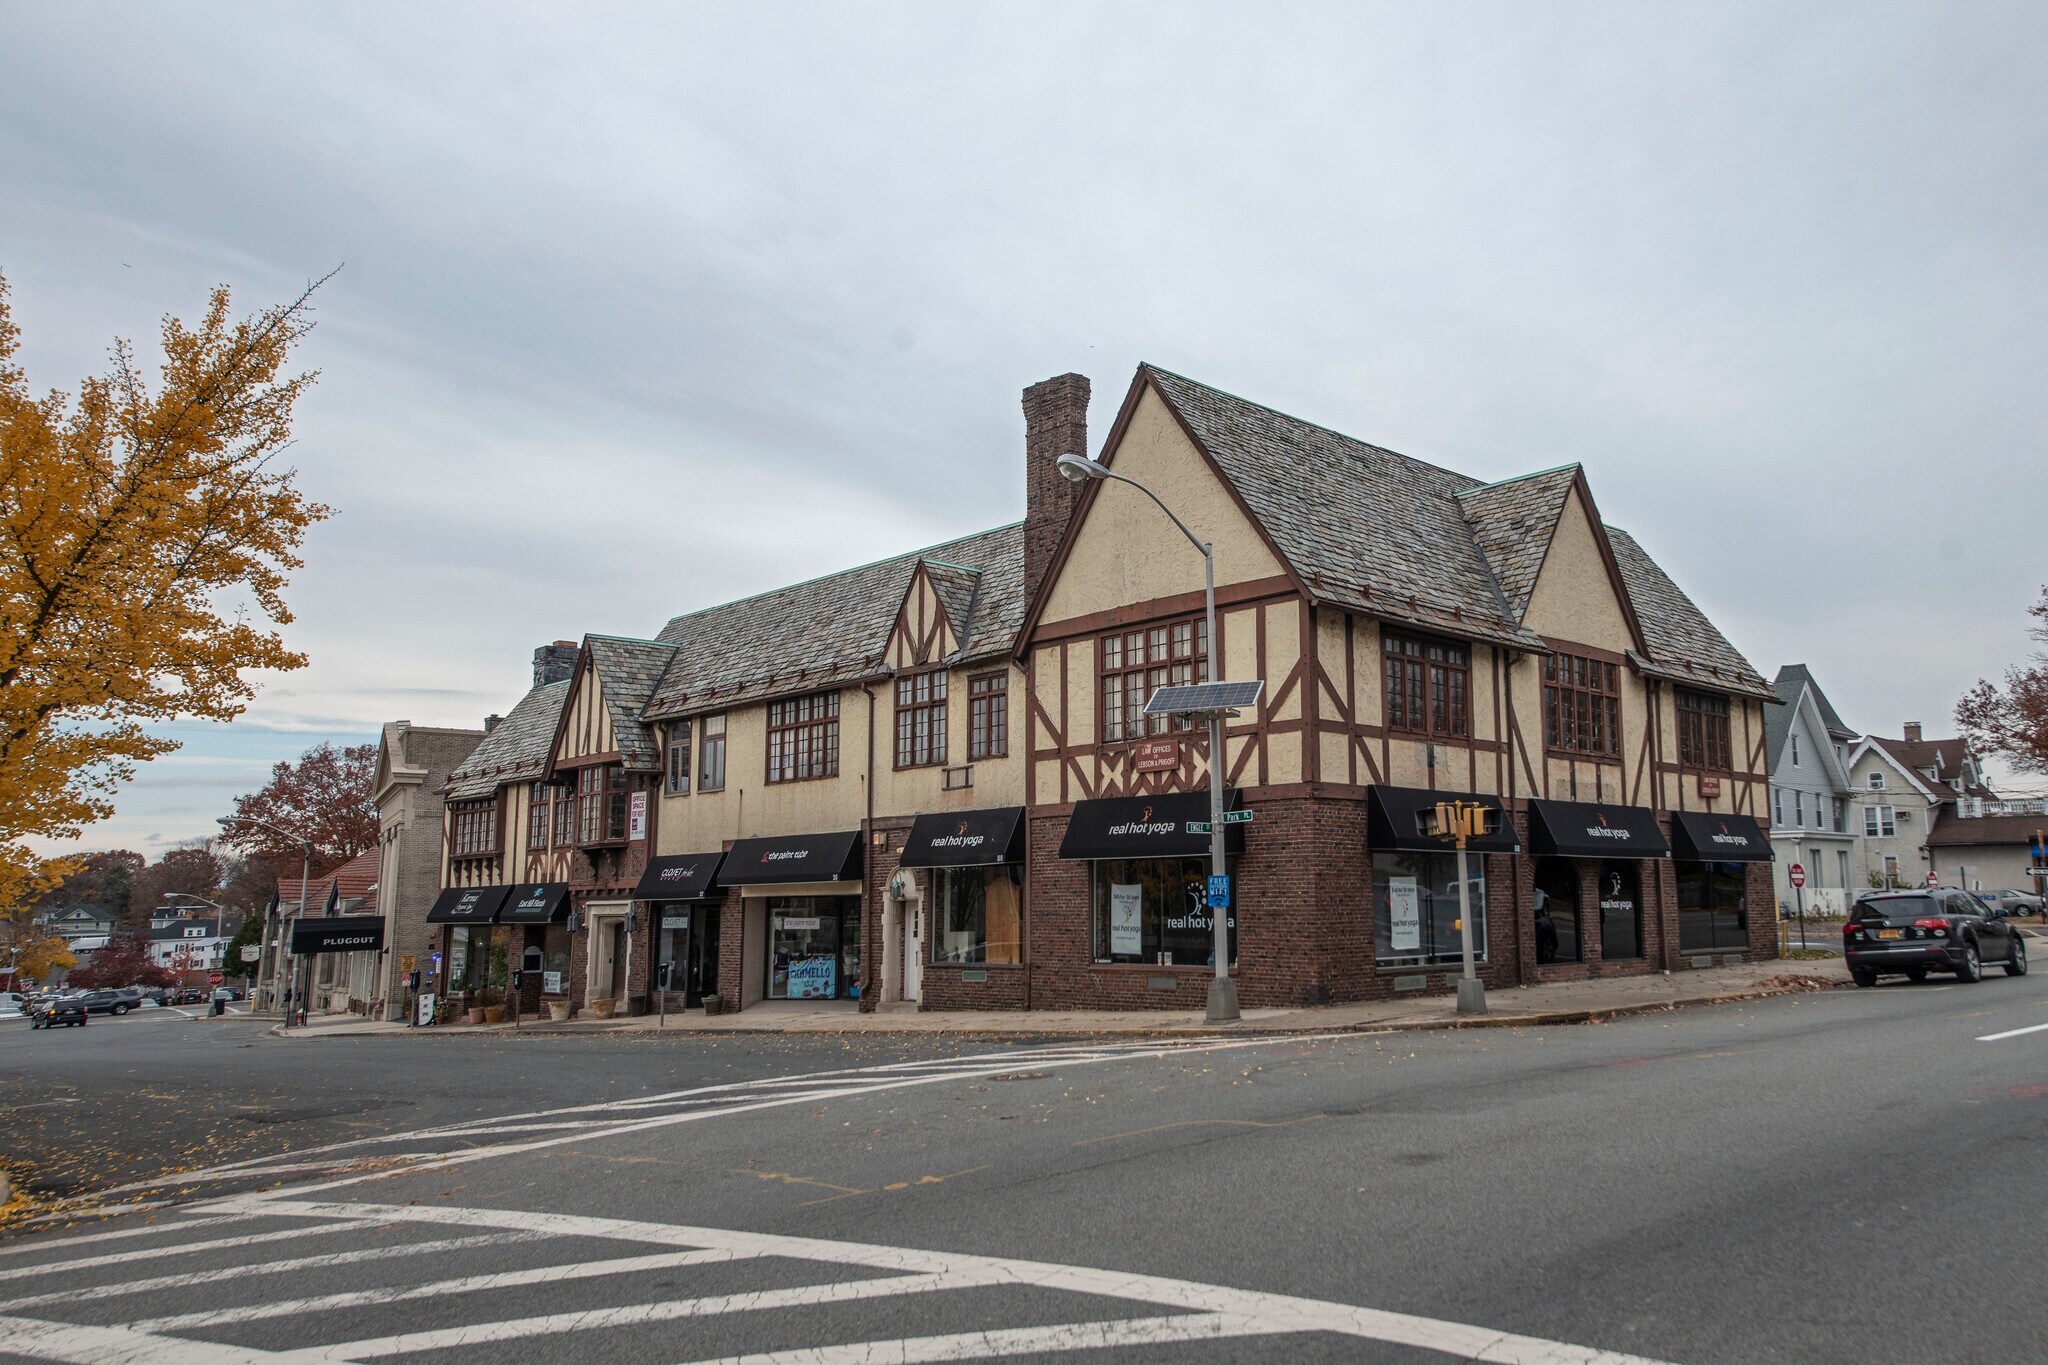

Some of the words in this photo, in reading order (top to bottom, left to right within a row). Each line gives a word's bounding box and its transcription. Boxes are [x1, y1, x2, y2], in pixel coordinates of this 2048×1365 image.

[1152, 745, 1171, 754] OFFICES
[1138, 760, 1154, 768] LEBSON
[1227, 813, 1239, 821] Park
[1109, 823, 1129, 835] real
[1129, 822, 1149, 834] hot
[1147, 822, 1175, 835] yoga
[1190, 824, 1203, 832] ENGLE
[1586, 827, 1600, 837] real
[1600, 828, 1613, 837] hot
[1611, 829, 1630, 840] yoga
[931, 836, 949, 847] real
[947, 835, 963, 846] hot
[961, 835, 984, 847] yoga
[1732, 836, 1748, 846] yoga
[768, 850, 779, 860] the
[778, 849, 794, 860] paint
[794, 849, 809, 859] tube
[1209, 877, 1228, 885] FREE
[1601, 900, 1610, 909] real
[1610, 900, 1619, 909] hot
[1620, 901, 1633, 910] yoga
[1167, 915, 1186, 928] real
[1188, 915, 1206, 928] hot
[1206, 918, 1235, 931] ya
[323, 936, 375, 946] PLUGOUT
